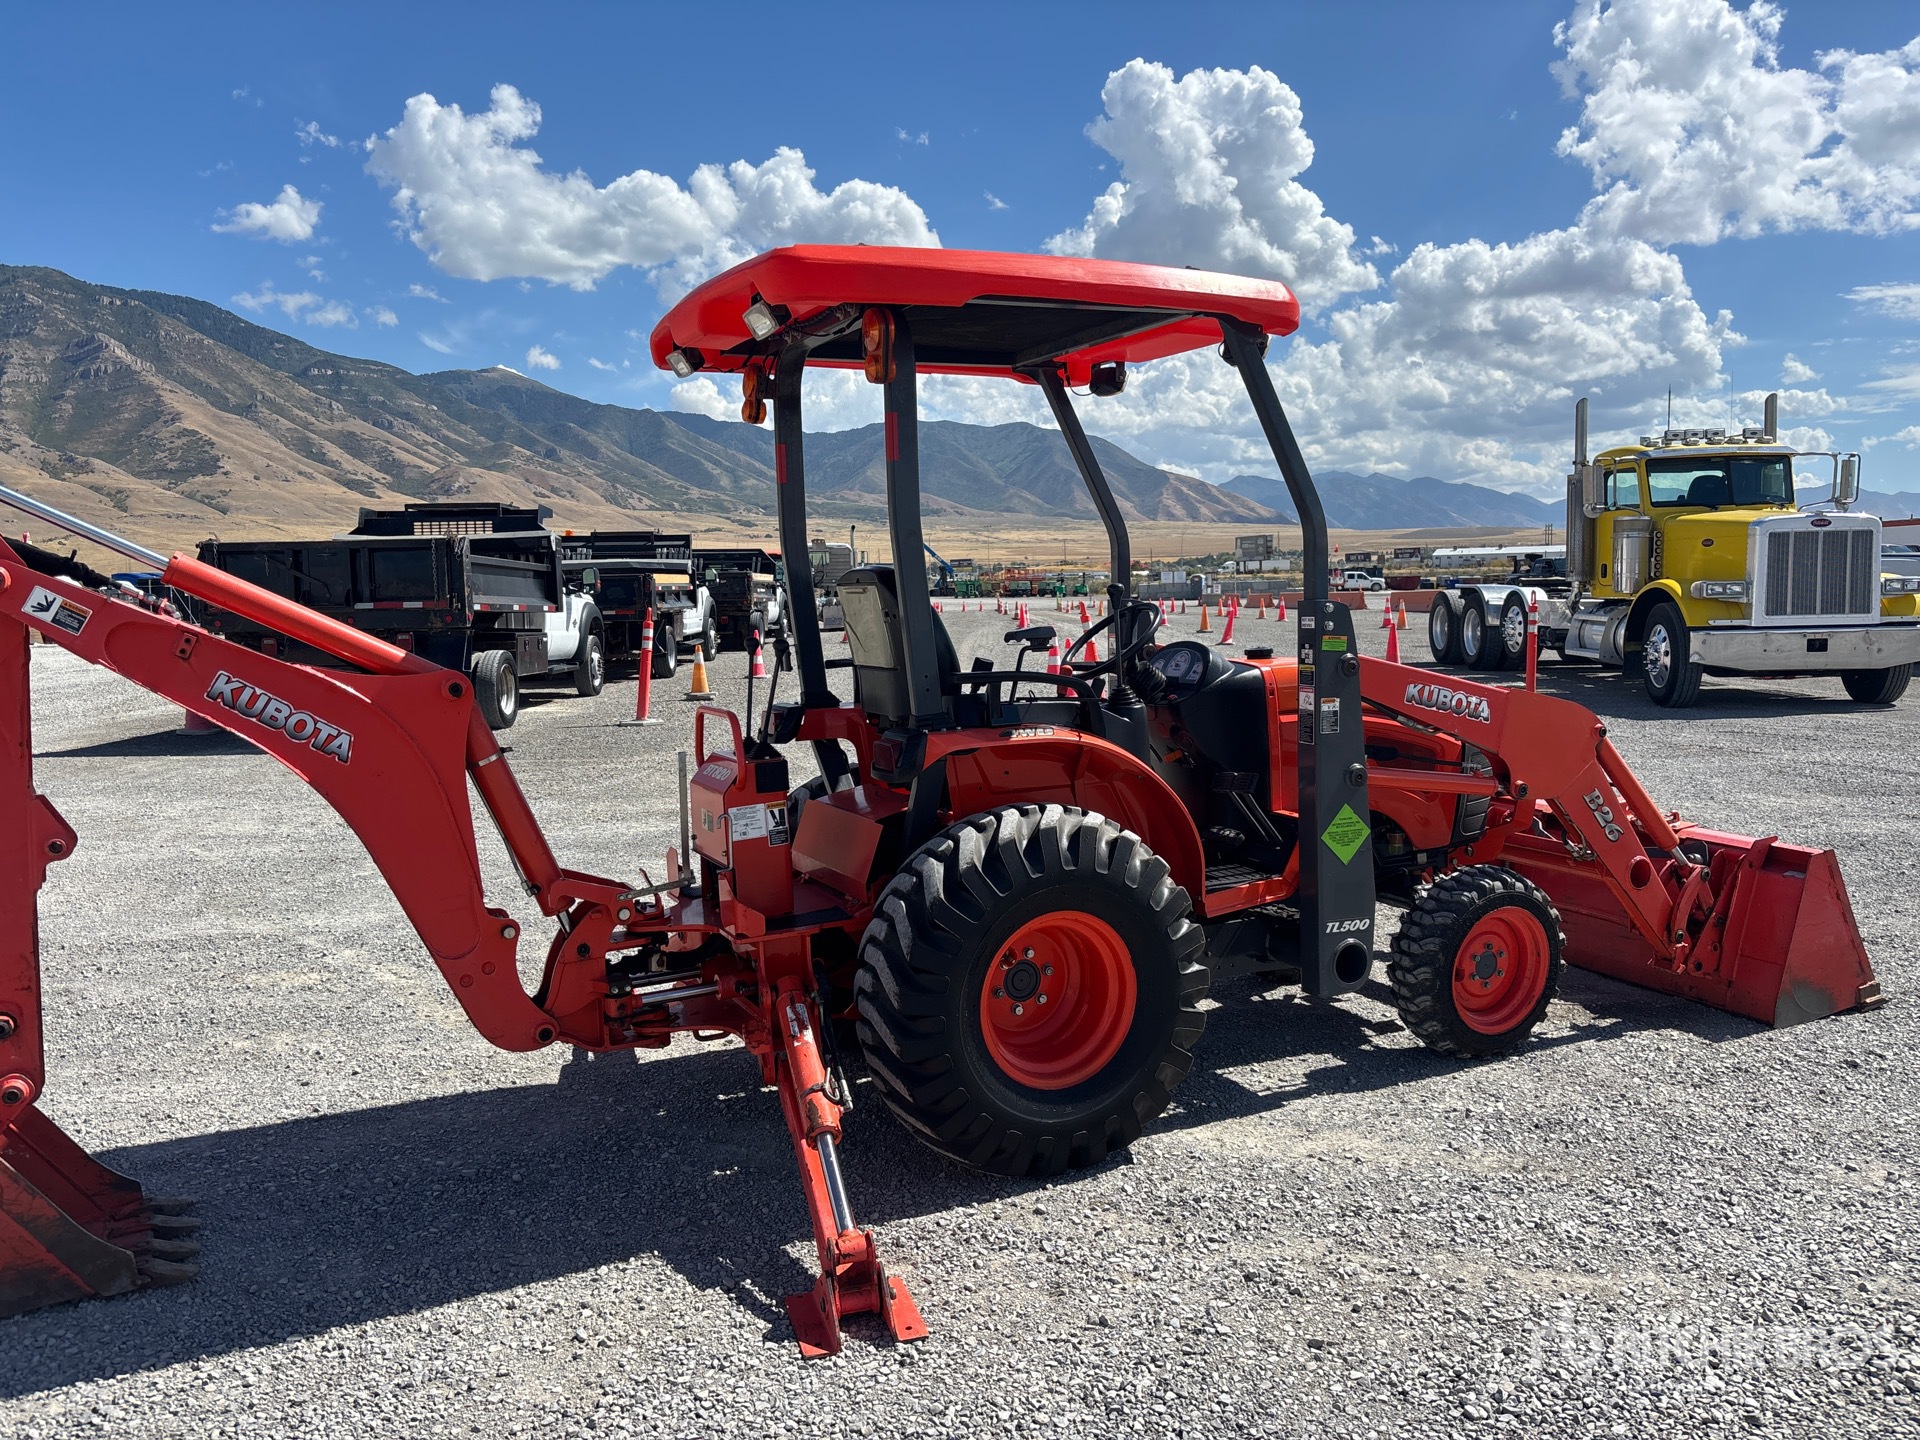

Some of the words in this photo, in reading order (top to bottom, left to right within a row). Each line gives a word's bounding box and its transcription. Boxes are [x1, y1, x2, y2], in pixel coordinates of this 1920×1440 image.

[205, 670, 355, 765] KUBOTA
[1404, 683, 1490, 724] KUBOTA
[1583, 787, 1625, 843] B26
[1325, 918, 1371, 934] TL500
